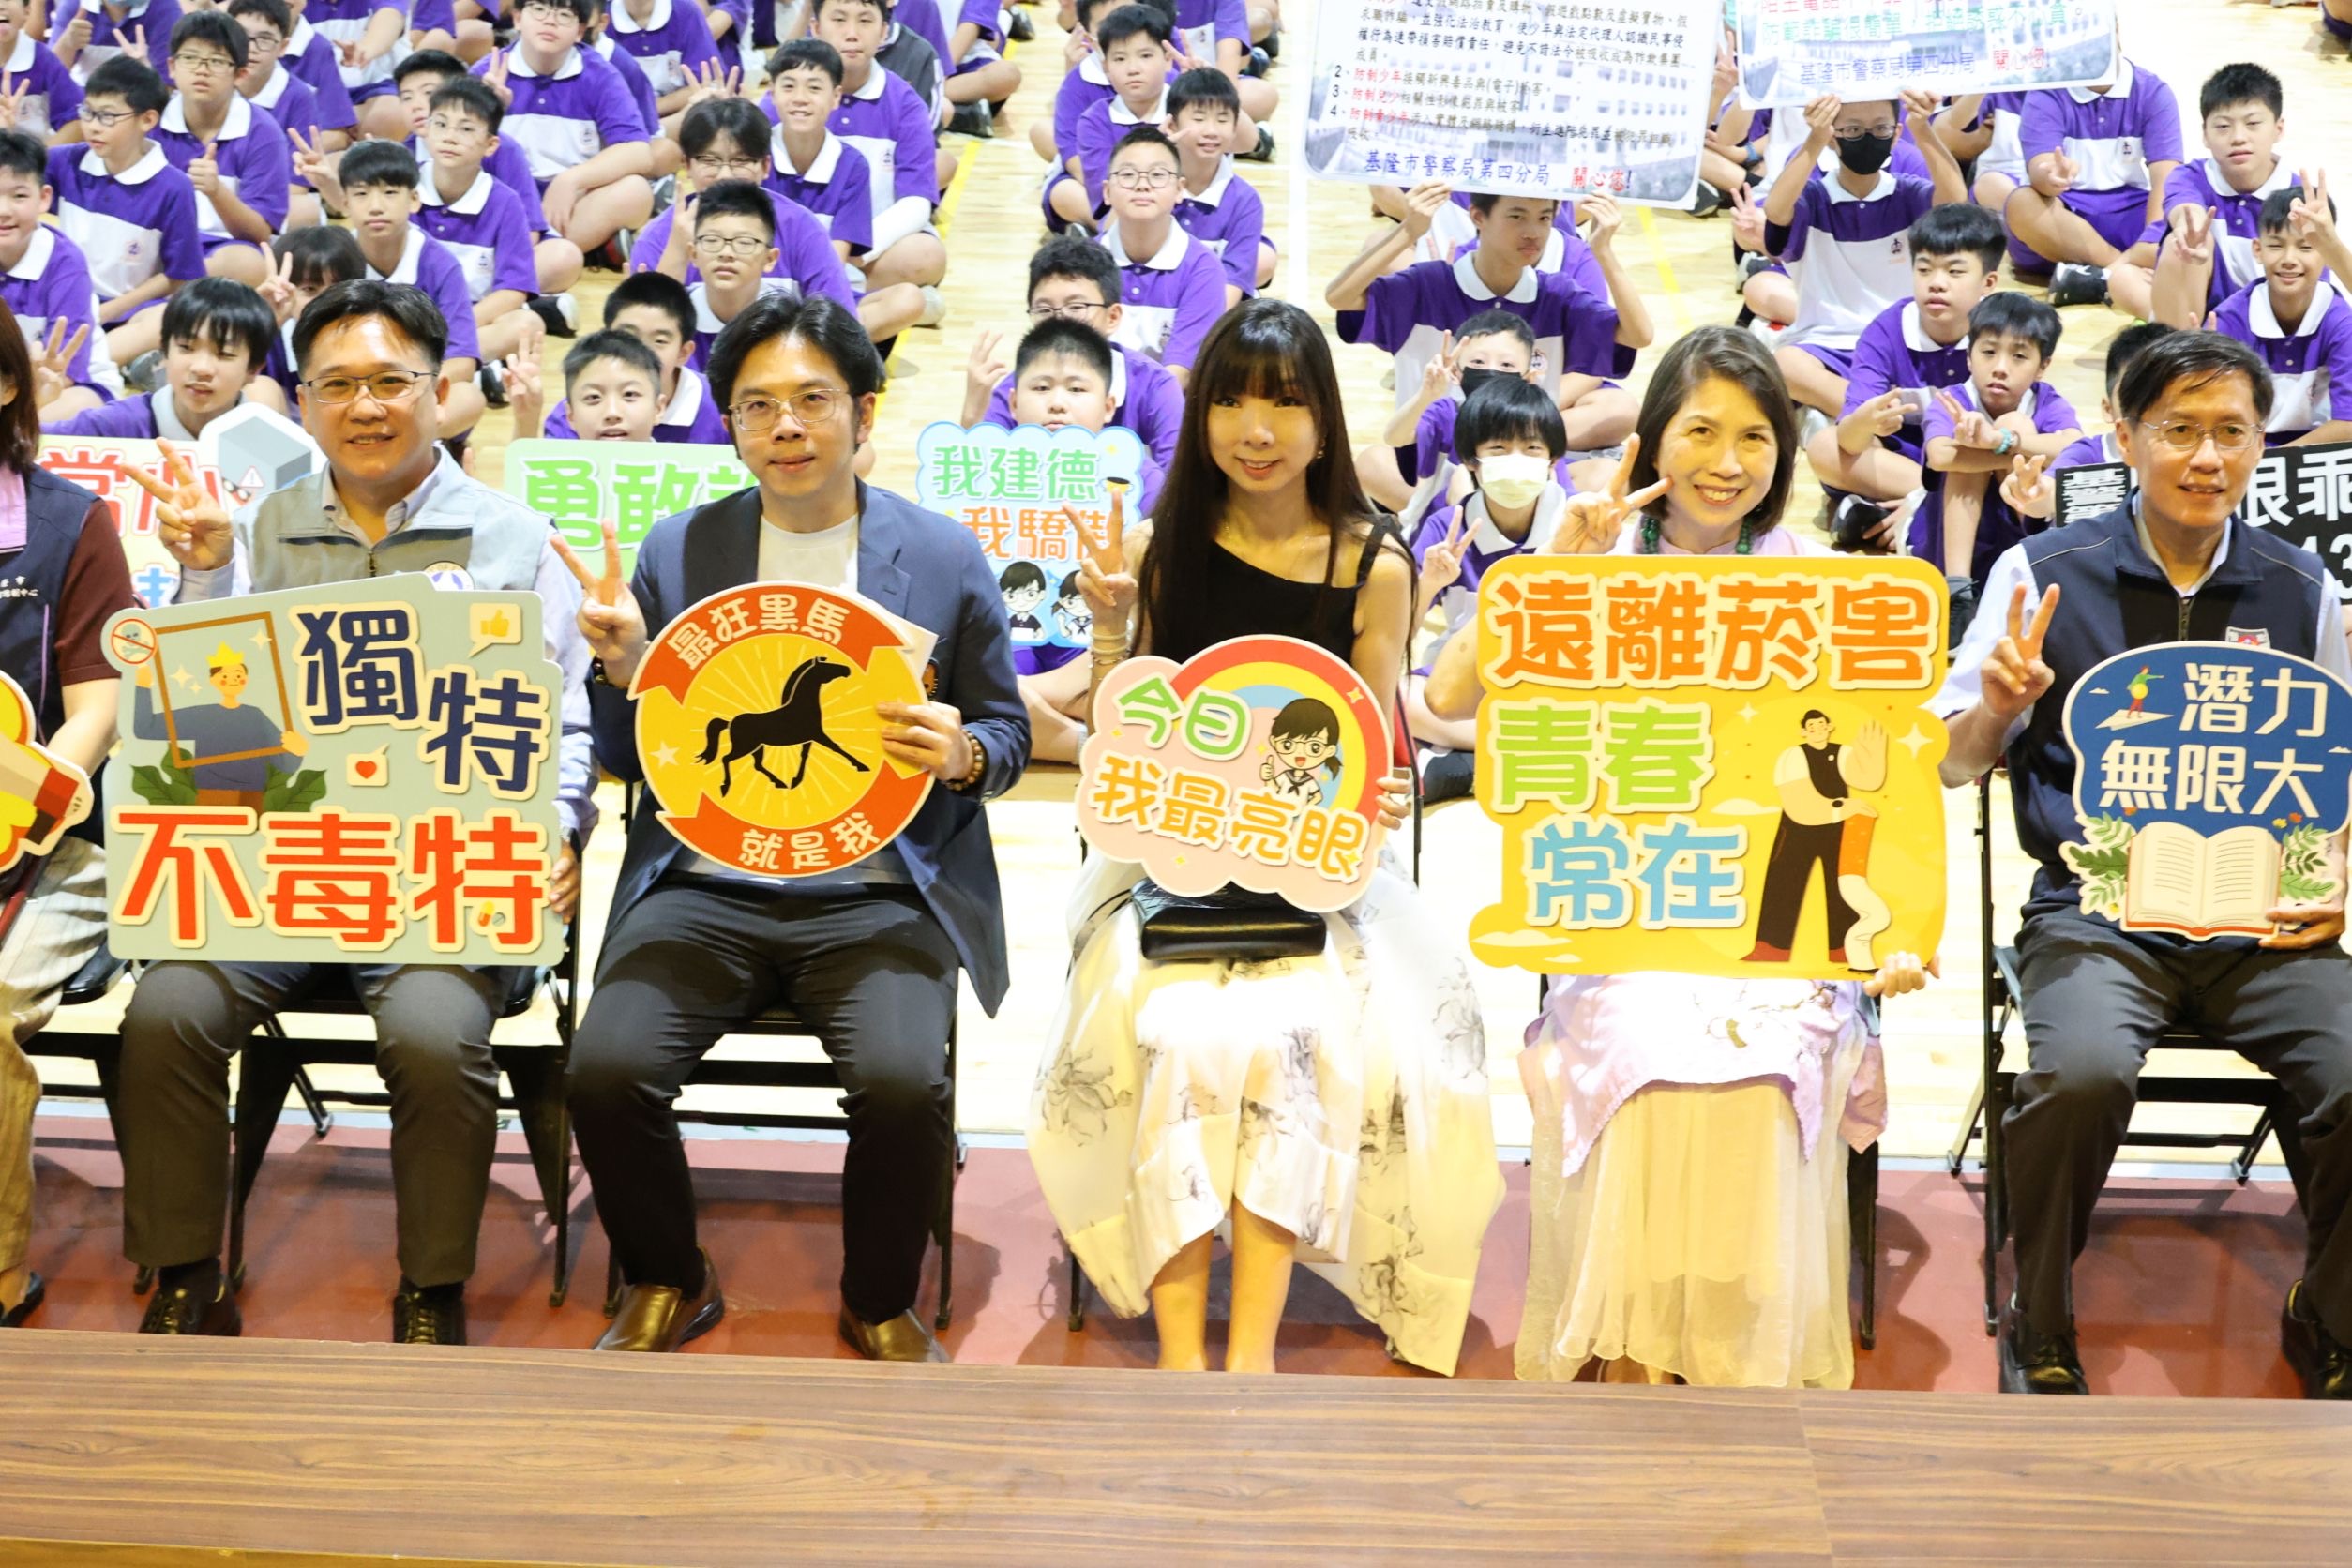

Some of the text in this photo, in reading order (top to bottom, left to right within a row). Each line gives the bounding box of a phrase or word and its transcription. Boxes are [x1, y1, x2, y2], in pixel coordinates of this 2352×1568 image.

[1364, 148, 1550, 187] 基隆市警察局第四分局
[932, 445, 1097, 501] 我建德
[666, 593, 851, 671] 最狂黑馬
[1493, 578, 1931, 684] 遠離菸害
[297, 608, 542, 792] 獨特
[1119, 676, 1247, 756] 今日
[2179, 661, 2329, 738] 潛力
[1495, 703, 1705, 807] 青春
[2098, 738, 2324, 819] 無限大
[738, 811, 881, 870] 就是我
[1093, 755, 1364, 878] 我最亮眼
[118, 812, 543, 945] 不毒特
[1530, 821, 1740, 922] 常在
